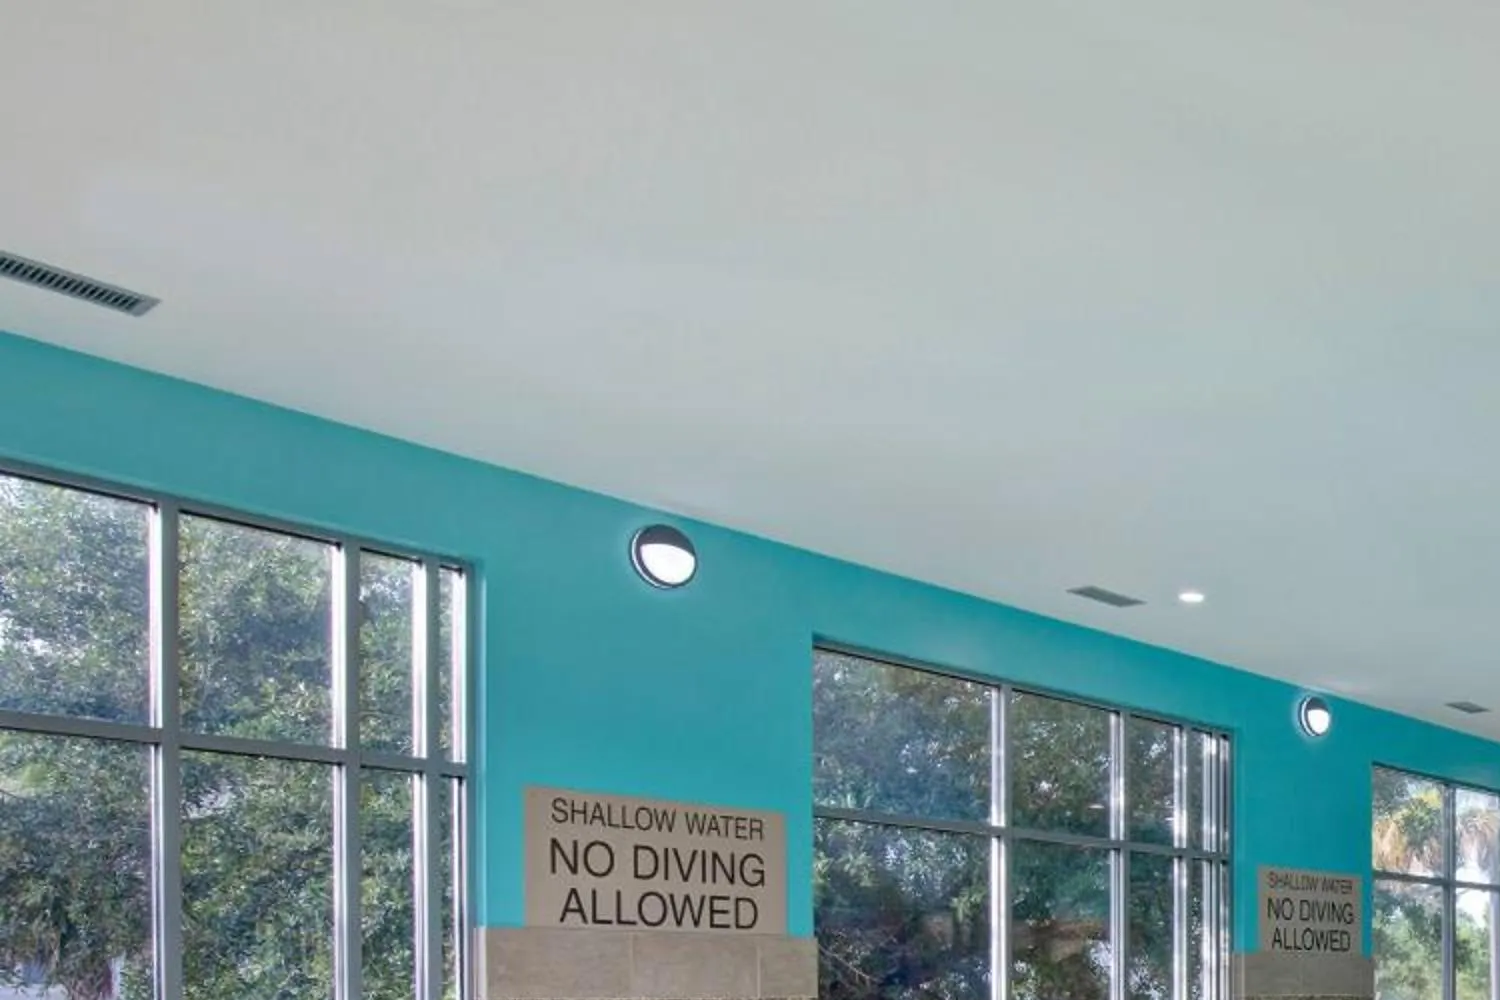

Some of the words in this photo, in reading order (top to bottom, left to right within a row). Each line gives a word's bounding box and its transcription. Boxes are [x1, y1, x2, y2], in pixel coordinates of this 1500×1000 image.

[551, 797, 676, 833] SHALLOW
[684, 812, 763, 841] WATER
[550, 838, 615, 877] NO
[633, 845, 765, 887] DIVING
[1267, 871, 1317, 891] SHALLOW
[1321, 877, 1353, 894] WATER
[559, 887, 759, 930] ALLOWED
[1267, 897, 1294, 921] NO
[1299, 899, 1354, 925] DIVING
[1271, 927, 1350, 953] ALLOWED
